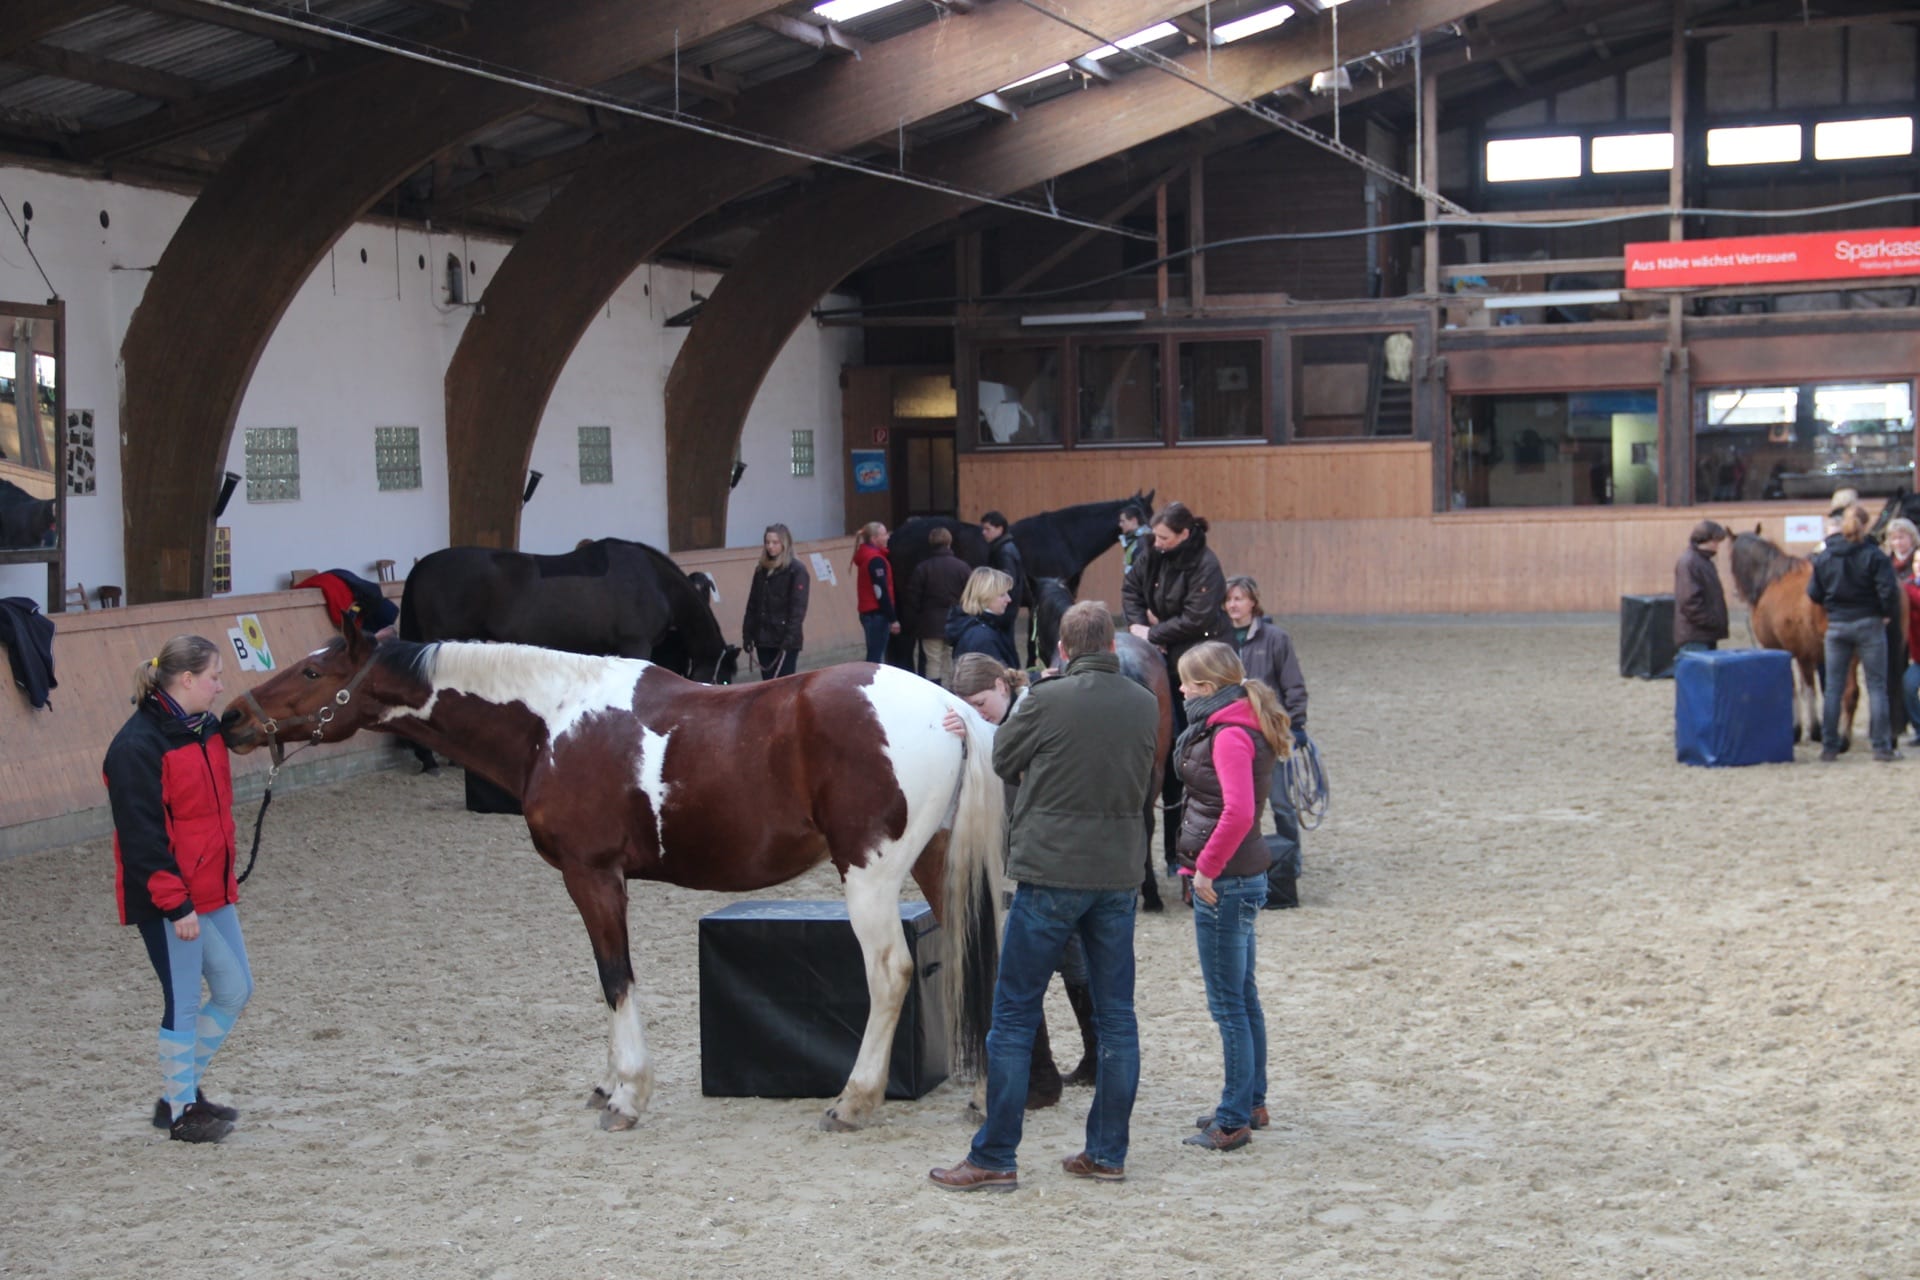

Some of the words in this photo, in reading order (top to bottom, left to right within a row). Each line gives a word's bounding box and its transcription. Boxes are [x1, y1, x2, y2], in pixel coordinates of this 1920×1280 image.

[1631, 259, 1656, 272] Aus
[1657, 256, 1689, 270] Nähe
[1691, 253, 1734, 268] wächst
[1735, 251, 1798, 265] Vertrauen
[233, 637, 249, 660] B
